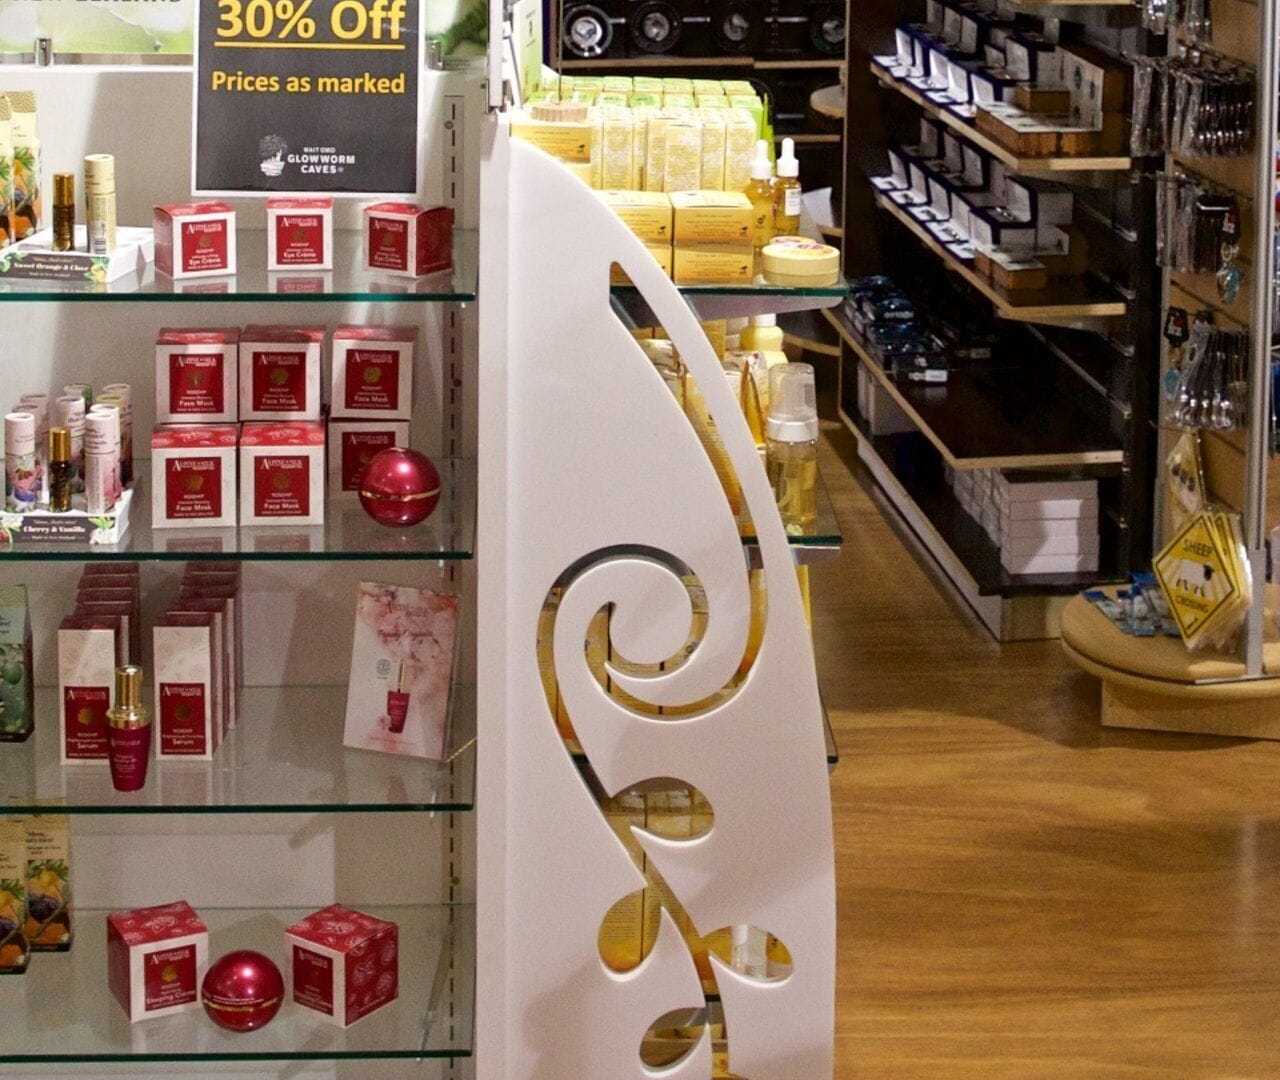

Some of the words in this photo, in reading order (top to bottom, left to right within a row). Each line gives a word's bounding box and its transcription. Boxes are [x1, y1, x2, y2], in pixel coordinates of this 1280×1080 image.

[212, 71, 281, 92] Prices
[286, 76, 311, 92] as
[317, 72, 406, 94] marked
[300, 164, 337, 175] CAVES
[283, 251, 295, 260] Eye
[374, 253, 384, 262] Eye
[13, 261, 34, 270] Sweet
[35, 262, 62, 271] Orange
[68, 263, 90, 271] Clove
[189, 258, 202, 266] Eye
[178, 399, 196, 407] Face
[196, 399, 215, 407] Mask
[261, 397, 278, 405] Face
[278, 397, 297, 405] Mask
[370, 395, 388, 403] Mask
[175, 504, 193, 512] Face
[193, 504, 212, 512] Mask
[263, 502, 280, 510] Face
[280, 502, 300, 510] Mask
[23, 525, 51, 534] Cherry
[1183, 540, 1213, 557] SHEEP
[172, 738, 194, 746] Serum
